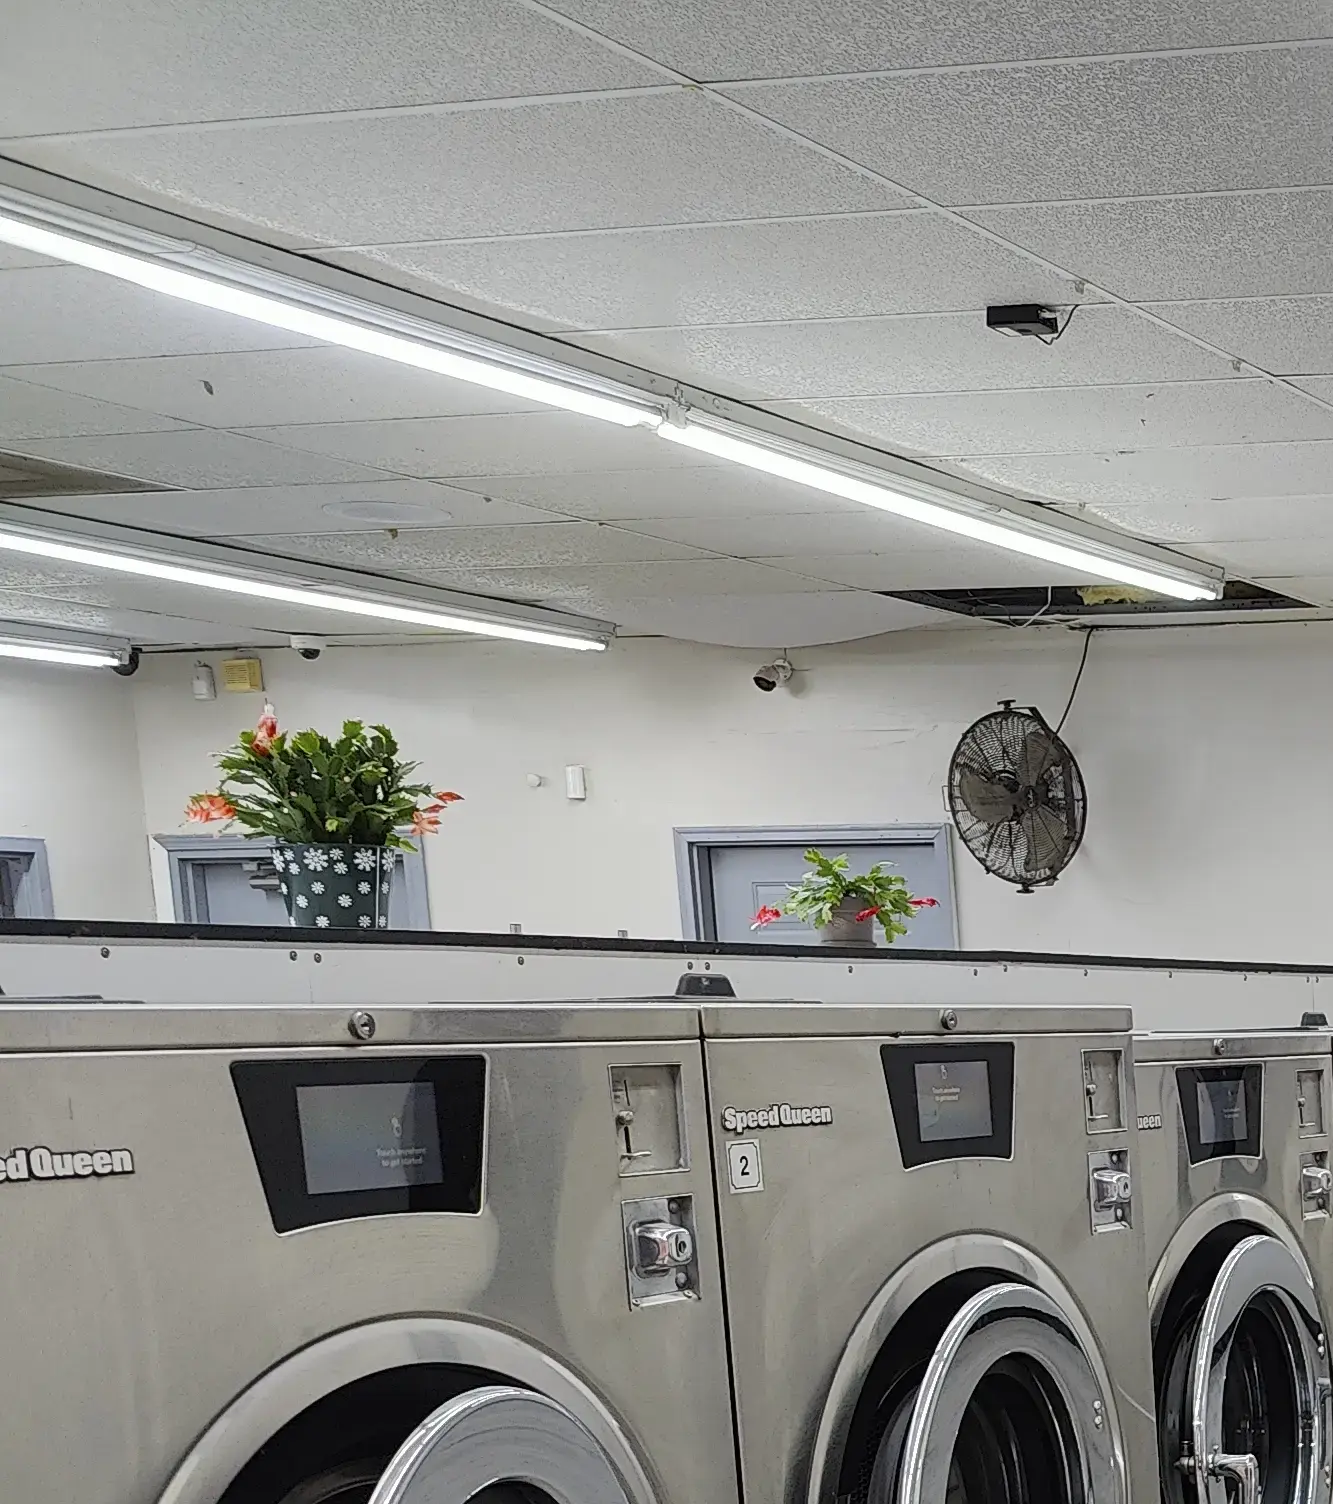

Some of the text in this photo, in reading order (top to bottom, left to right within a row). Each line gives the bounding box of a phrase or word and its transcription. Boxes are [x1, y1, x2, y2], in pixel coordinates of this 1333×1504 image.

[722, 1103, 833, 1135] Speed Queen
[1137, 1114, 1162, 1131] ueen
[29, 1146, 135, 1180] Queen
[739, 1155, 750, 1176] 2
